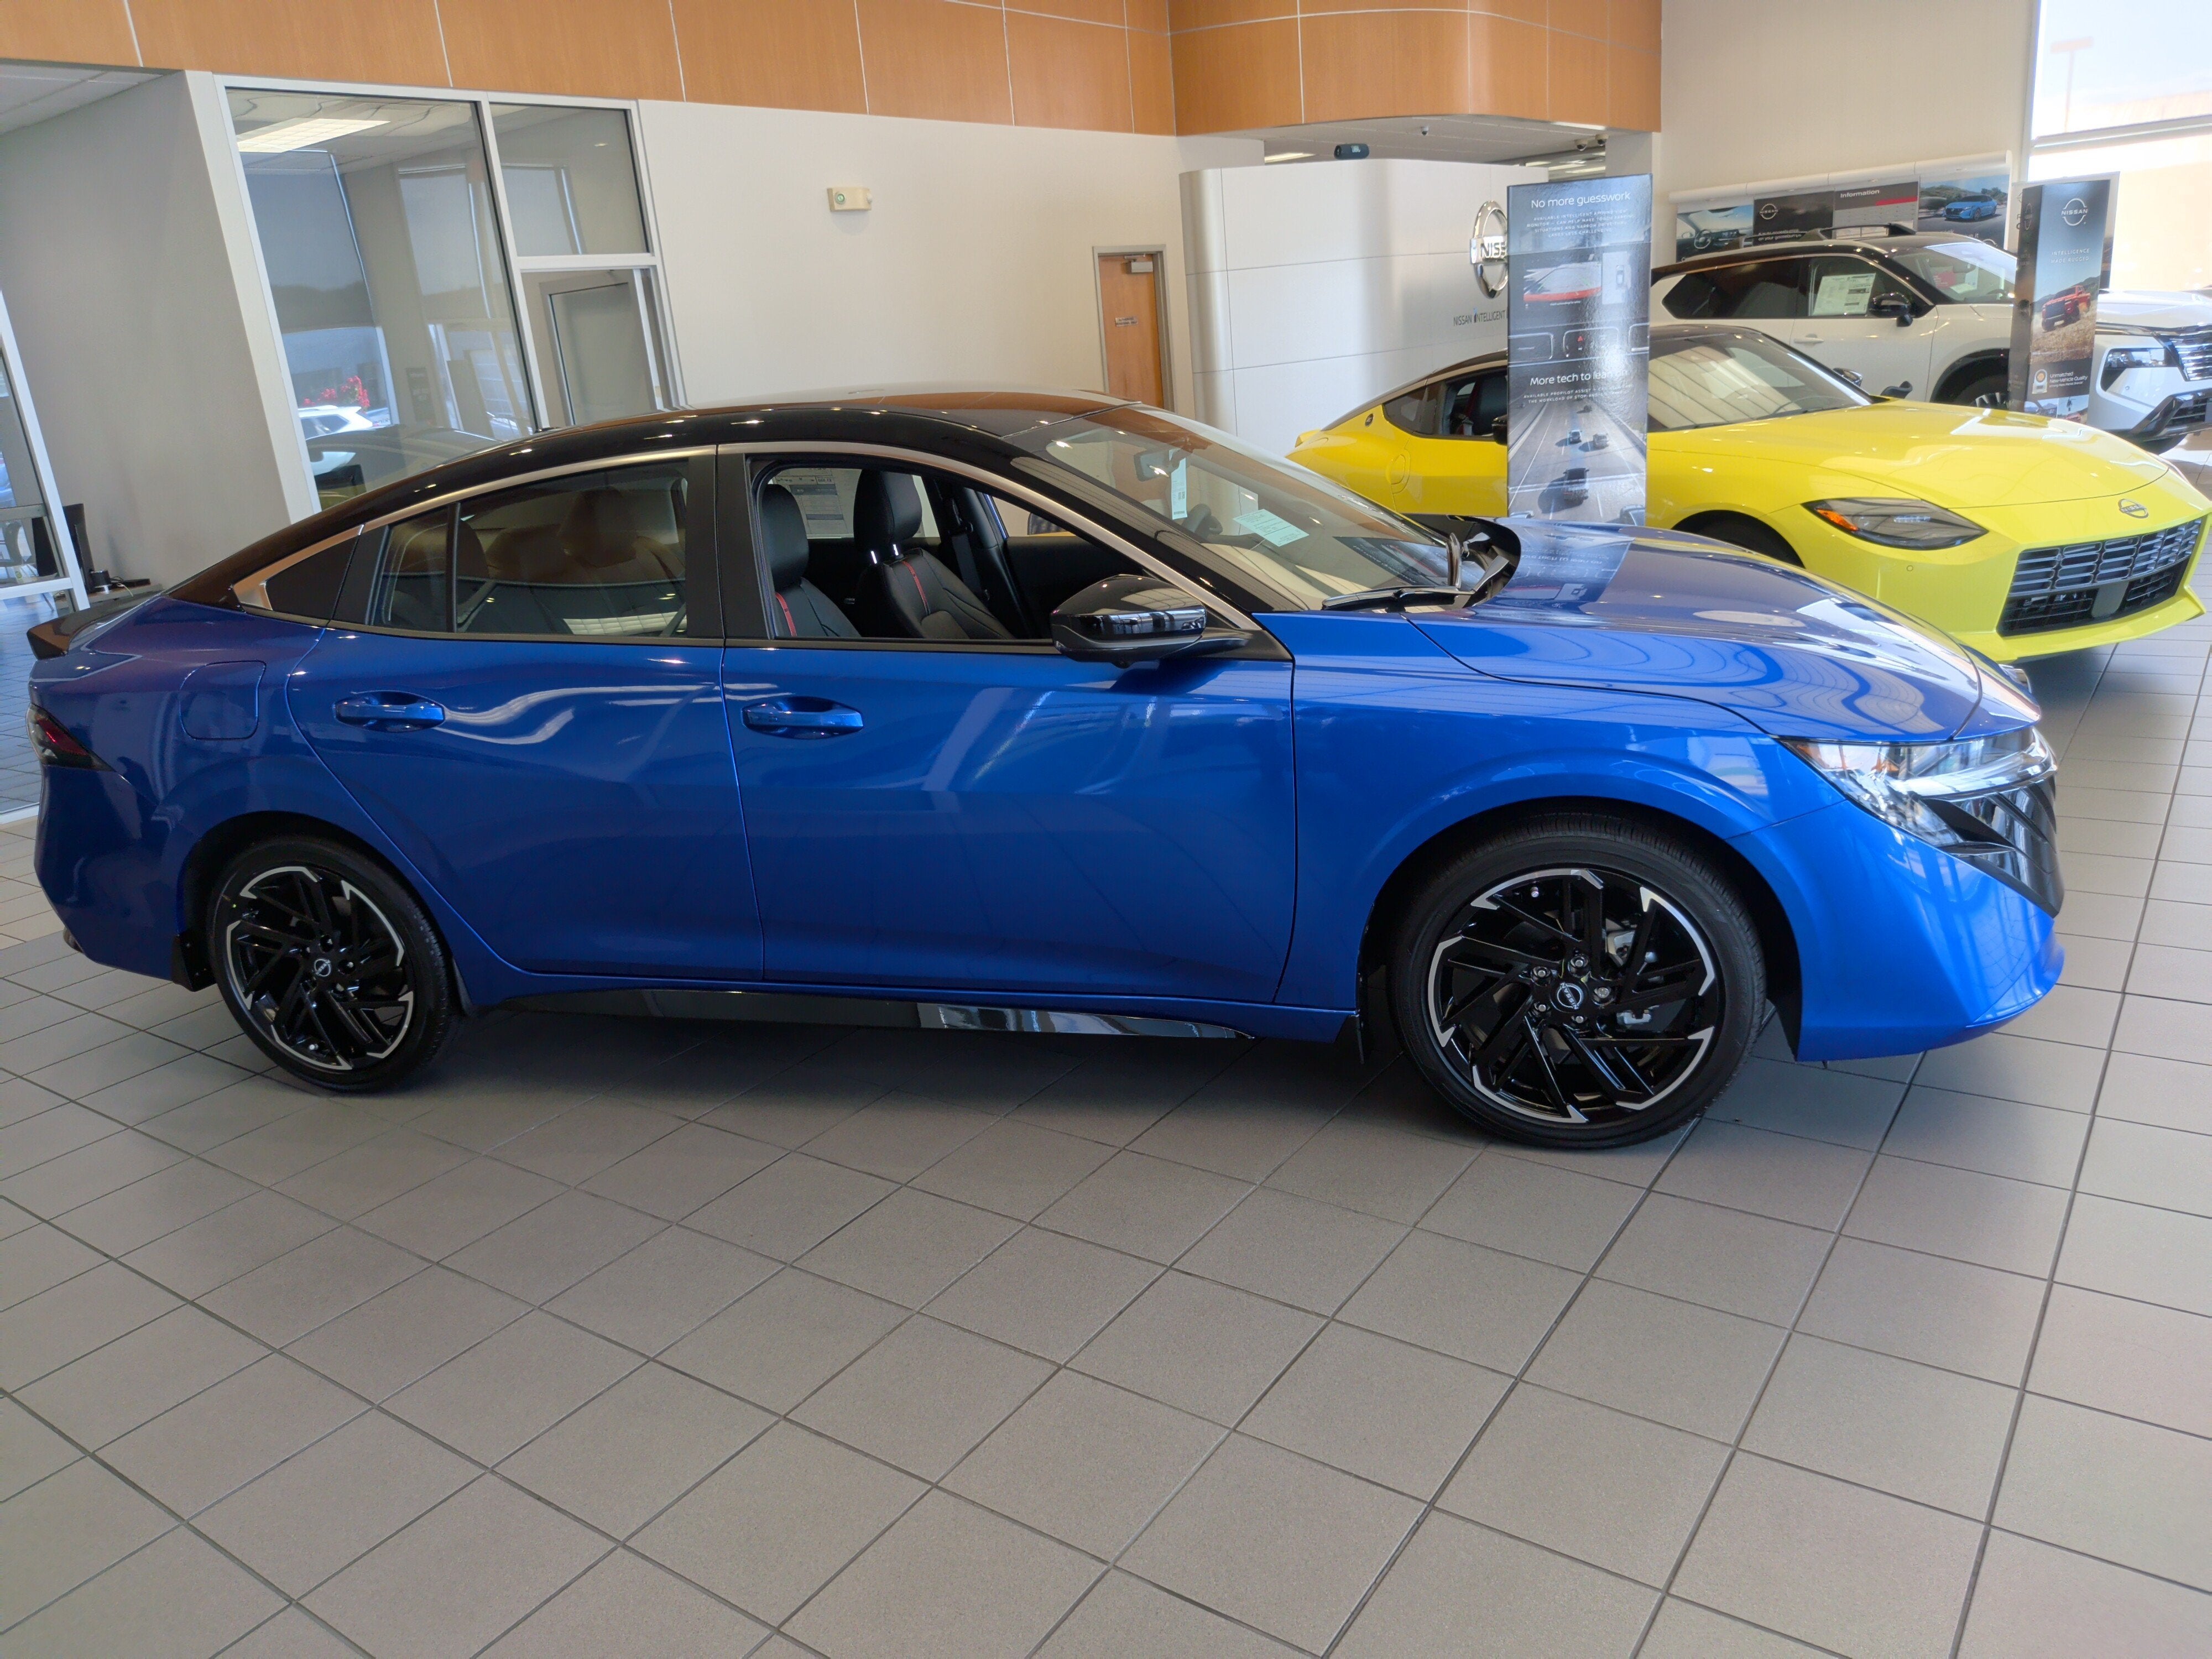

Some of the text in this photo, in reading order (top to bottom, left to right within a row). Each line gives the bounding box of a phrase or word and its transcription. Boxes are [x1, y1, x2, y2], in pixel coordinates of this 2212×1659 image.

[1531, 191, 1631, 209] No more guesswork
[1840, 189, 1880, 199] Information
[1480, 241, 1507, 257] NISS
[1453, 314, 1472, 327] NISSAN
[1530, 377, 1554, 386] More
[1557, 373, 1579, 383] tech
[1580, 373, 1591, 381] to
[1560, 982, 1579, 1010] NISSAN
